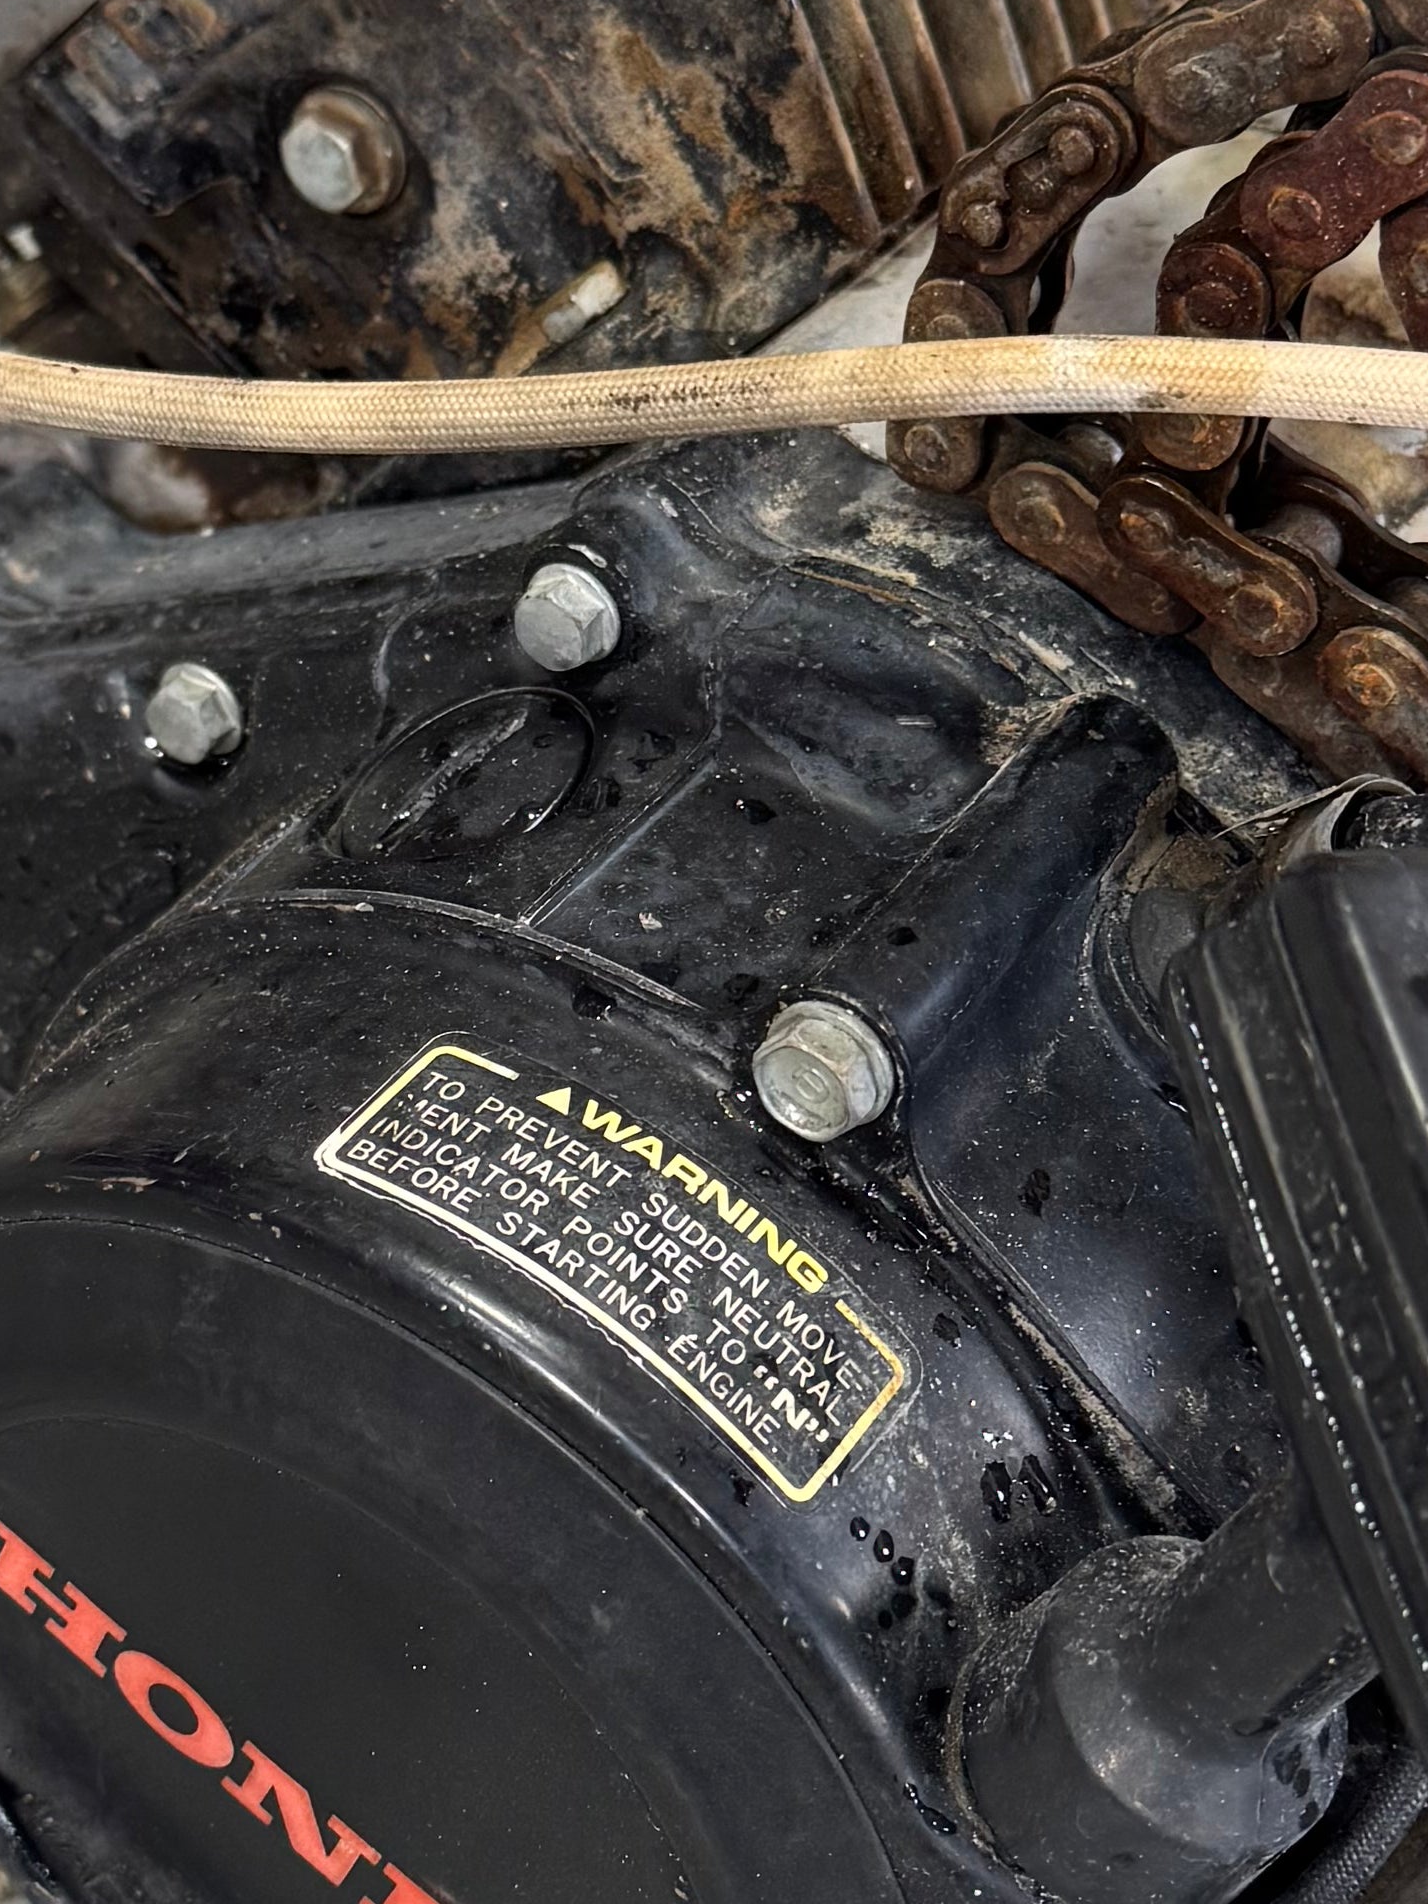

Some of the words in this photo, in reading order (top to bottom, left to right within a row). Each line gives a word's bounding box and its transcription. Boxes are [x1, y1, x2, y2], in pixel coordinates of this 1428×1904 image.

[347, 1139, 482, 1213] BEFORE
[496, 1212, 656, 1330] STARTING
[667, 1334, 780, 1453] ENGINE.
[370, 1117, 550, 1215] INDICATOR
[562, 1216, 688, 1314] POINTS
[706, 1319, 746, 1365] TO
[422, 1071, 465, 1100] TO
[475, 1096, 632, 1187] PREVENT
[642, 1193, 769, 1298] SUDDEN
[501, 1143, 600, 1209] MAKE
[614, 1211, 703, 1284] SURE
[713, 1286, 840, 1426] NEUTRAL
[581, 1099, 828, 1294] WARNING
